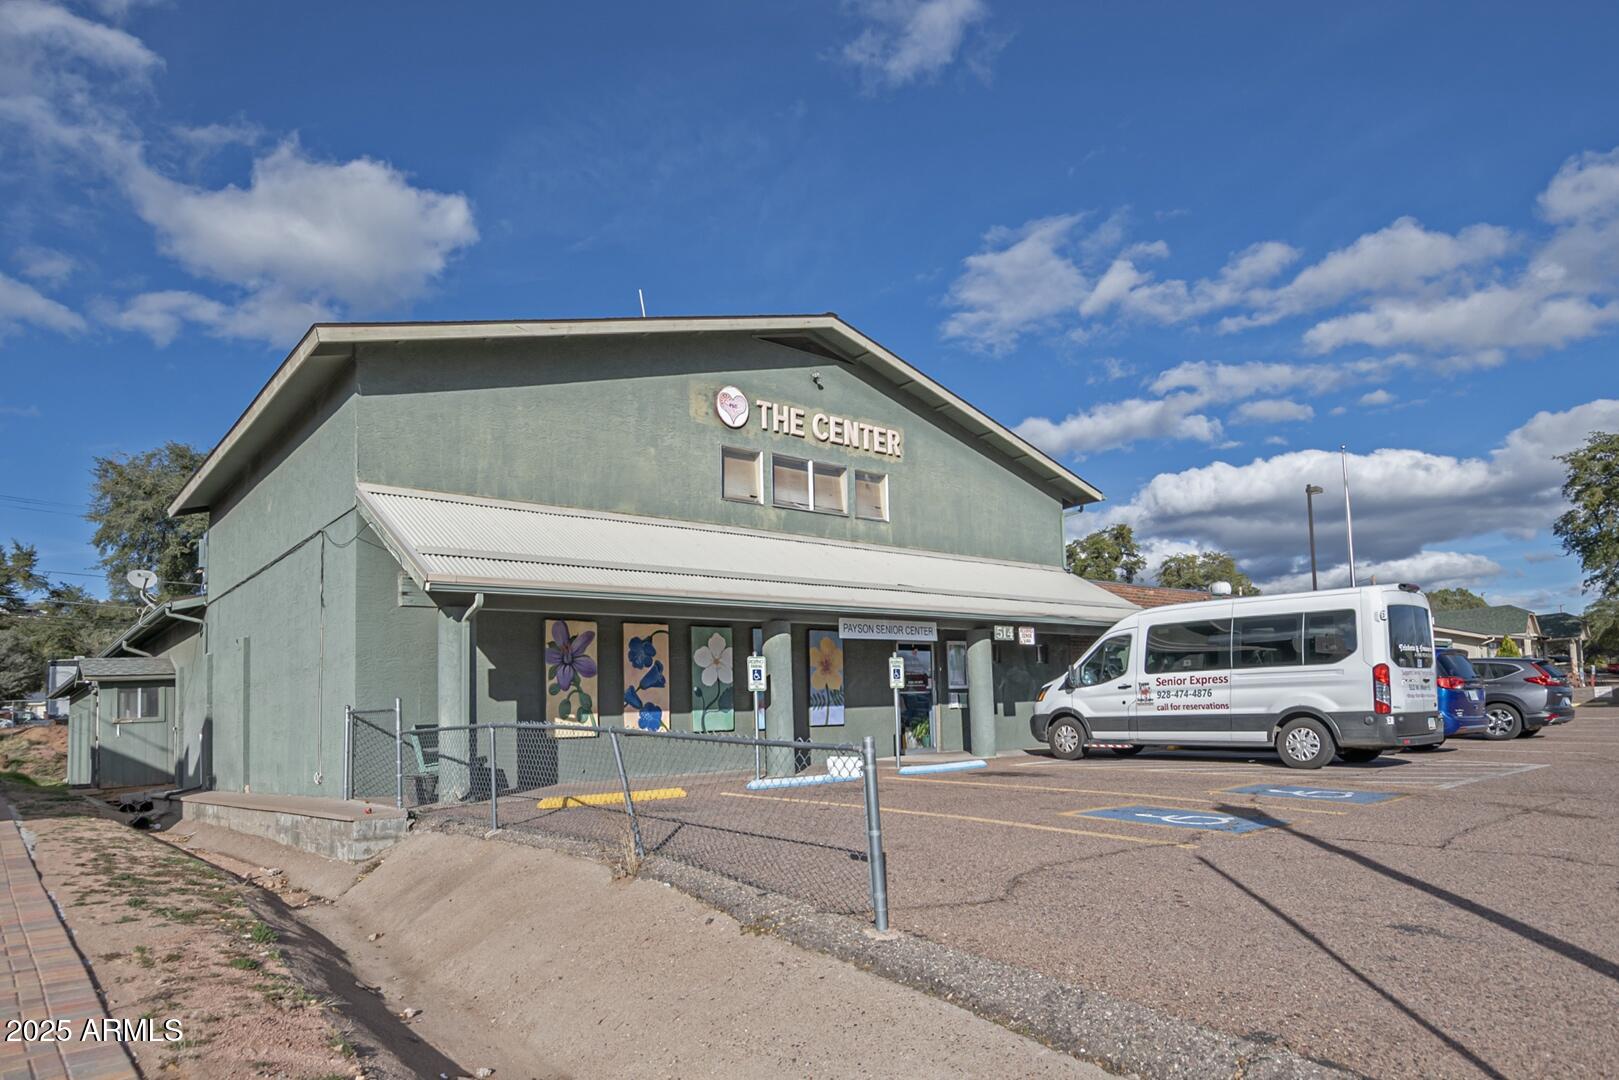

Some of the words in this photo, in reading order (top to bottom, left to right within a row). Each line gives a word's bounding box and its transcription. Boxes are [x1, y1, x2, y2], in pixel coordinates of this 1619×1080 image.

[757, 400, 805, 437] THE
[812, 413, 902, 457] CENTER
[843, 623, 875, 634] PAYSON
[876, 624, 903, 635] SENIOR
[905, 625, 934, 636] CENTER
[996, 627, 1014, 639] 514
[1156, 676, 1187, 686] Senior
[1190, 675, 1229, 686] Express
[1157, 689, 1212, 699] 928-474-4876
[1170, 703, 1181, 711] for
[1183, 702, 1229, 710] reservations
